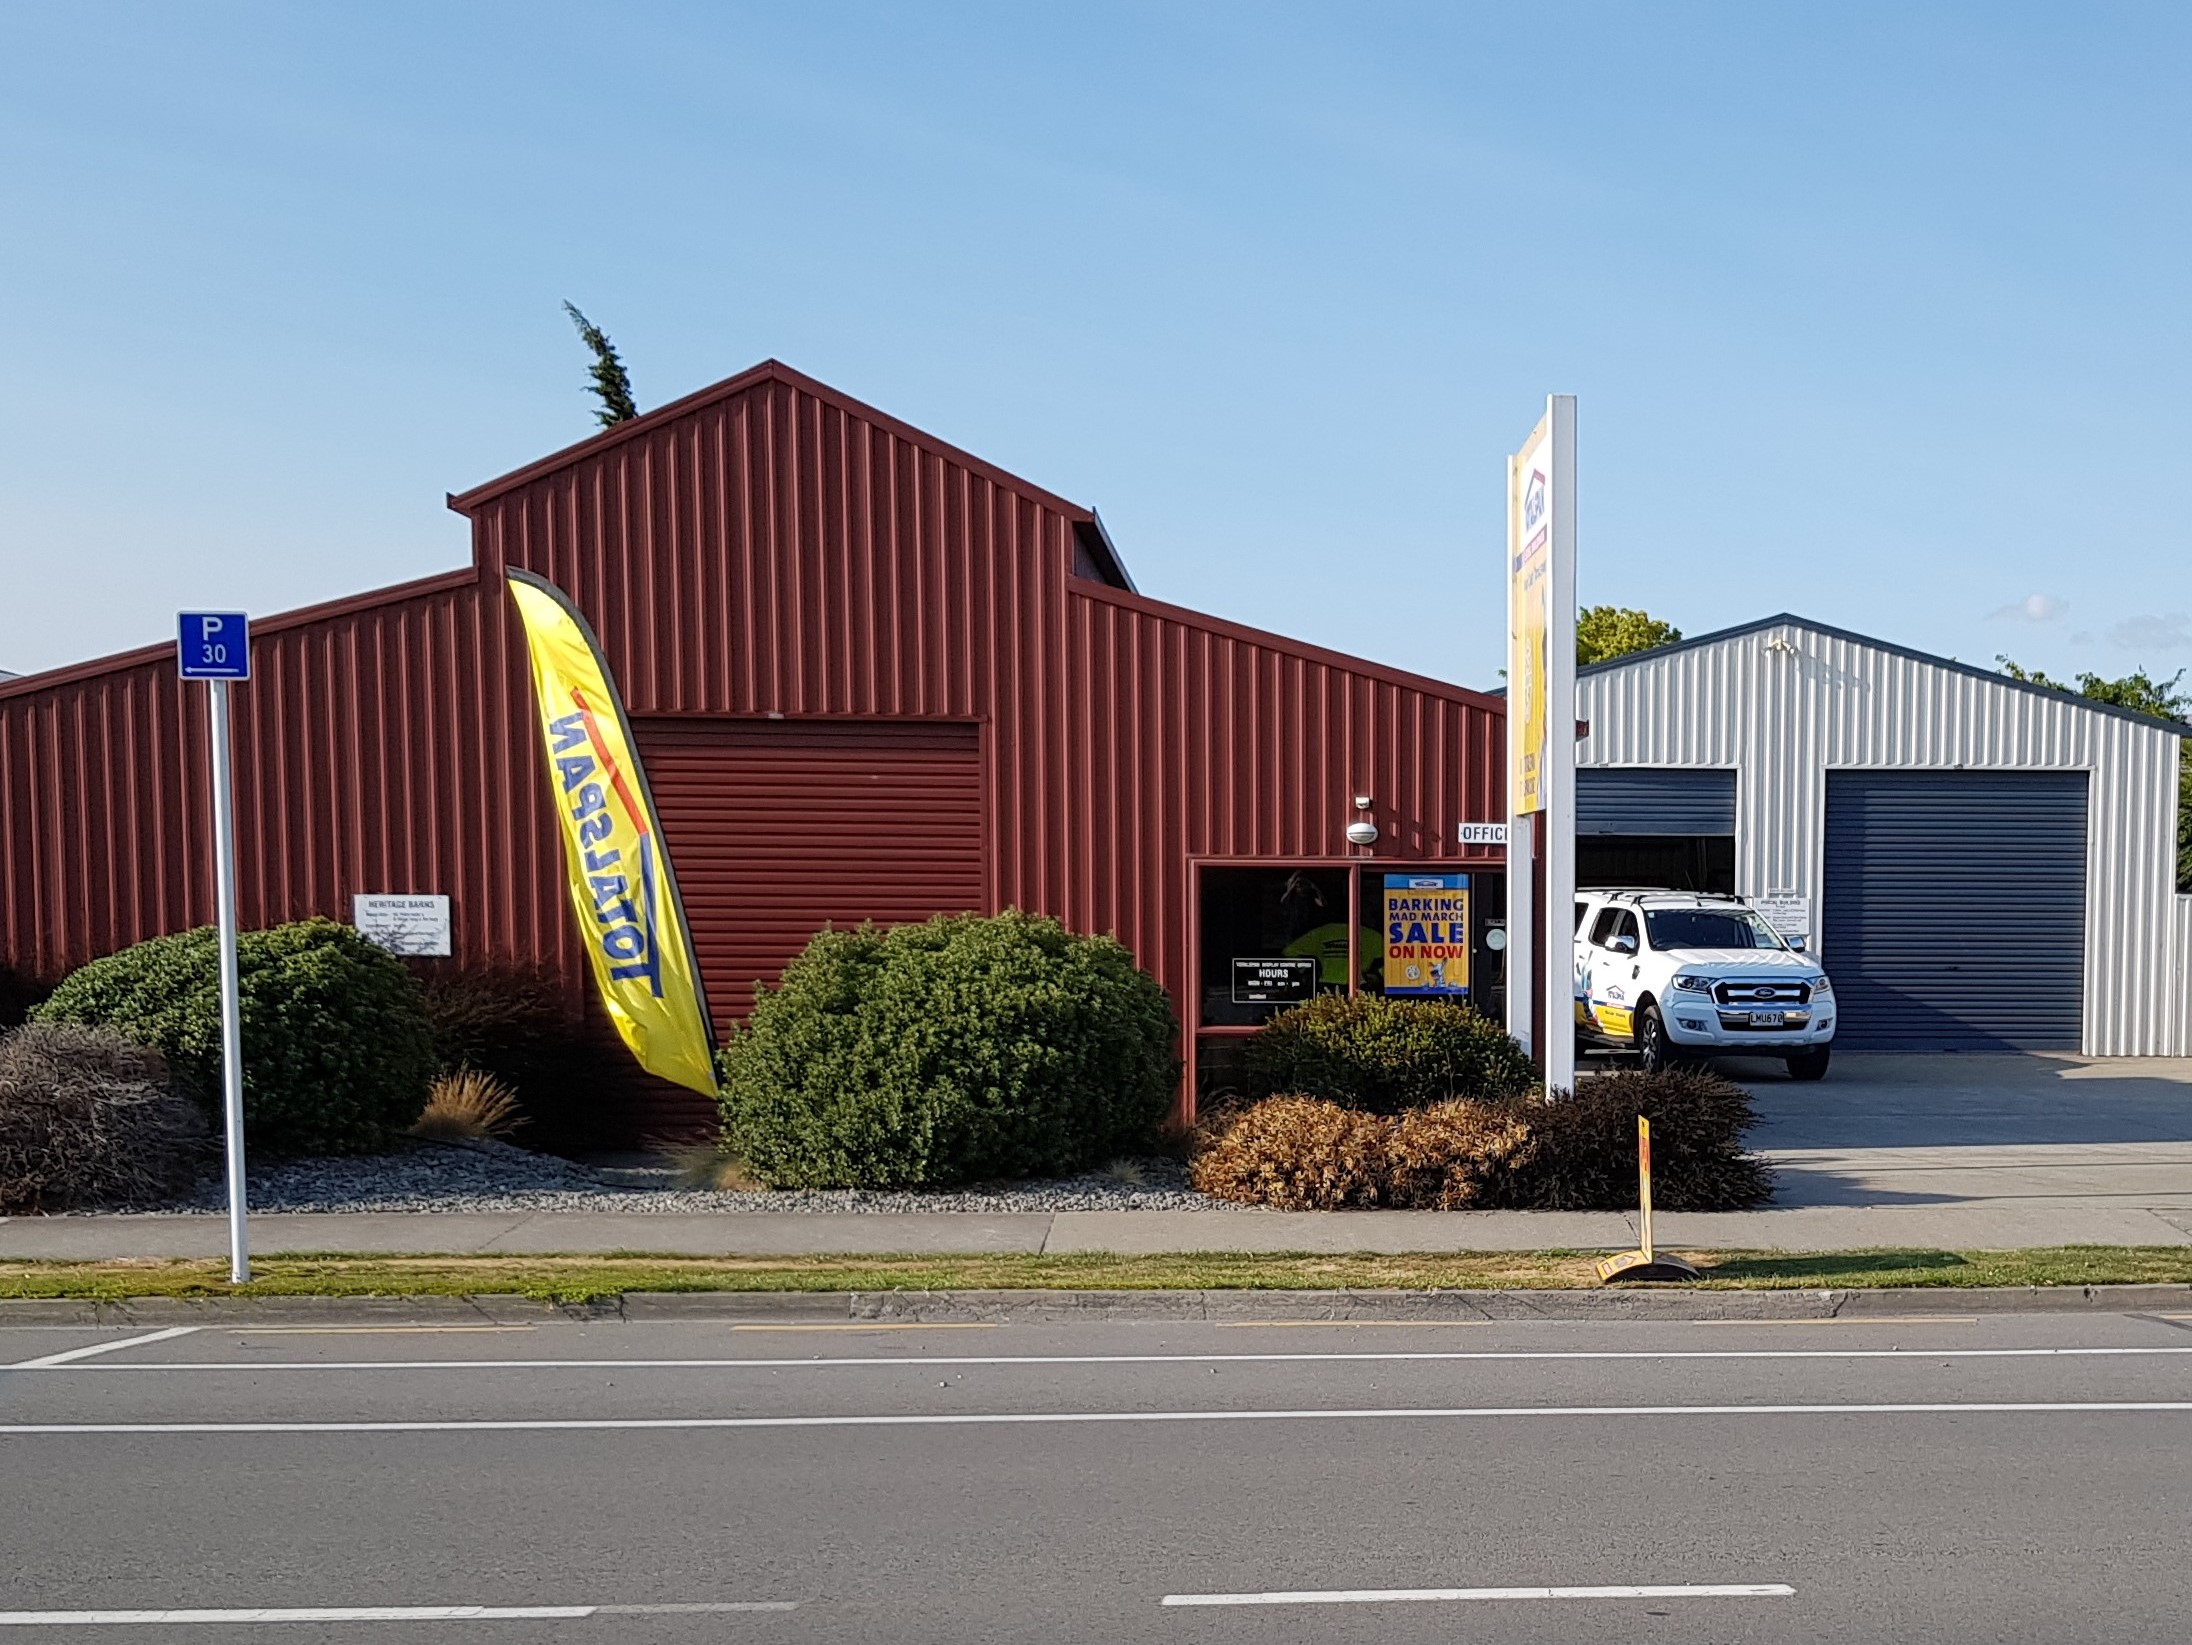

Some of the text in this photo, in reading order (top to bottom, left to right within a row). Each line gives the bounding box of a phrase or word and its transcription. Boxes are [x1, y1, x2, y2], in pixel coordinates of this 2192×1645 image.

[201, 616, 223, 641] P
[202, 643, 227, 664] 30
[1463, 826, 1508, 840] OFFIC
[1388, 898, 1464, 911] BARKING
[1389, 912, 1464, 922] MAD MARCH
[1389, 922, 1464, 944] SALE
[1389, 945, 1464, 959] ON NOW
[1258, 968, 1289, 978] HOURS
